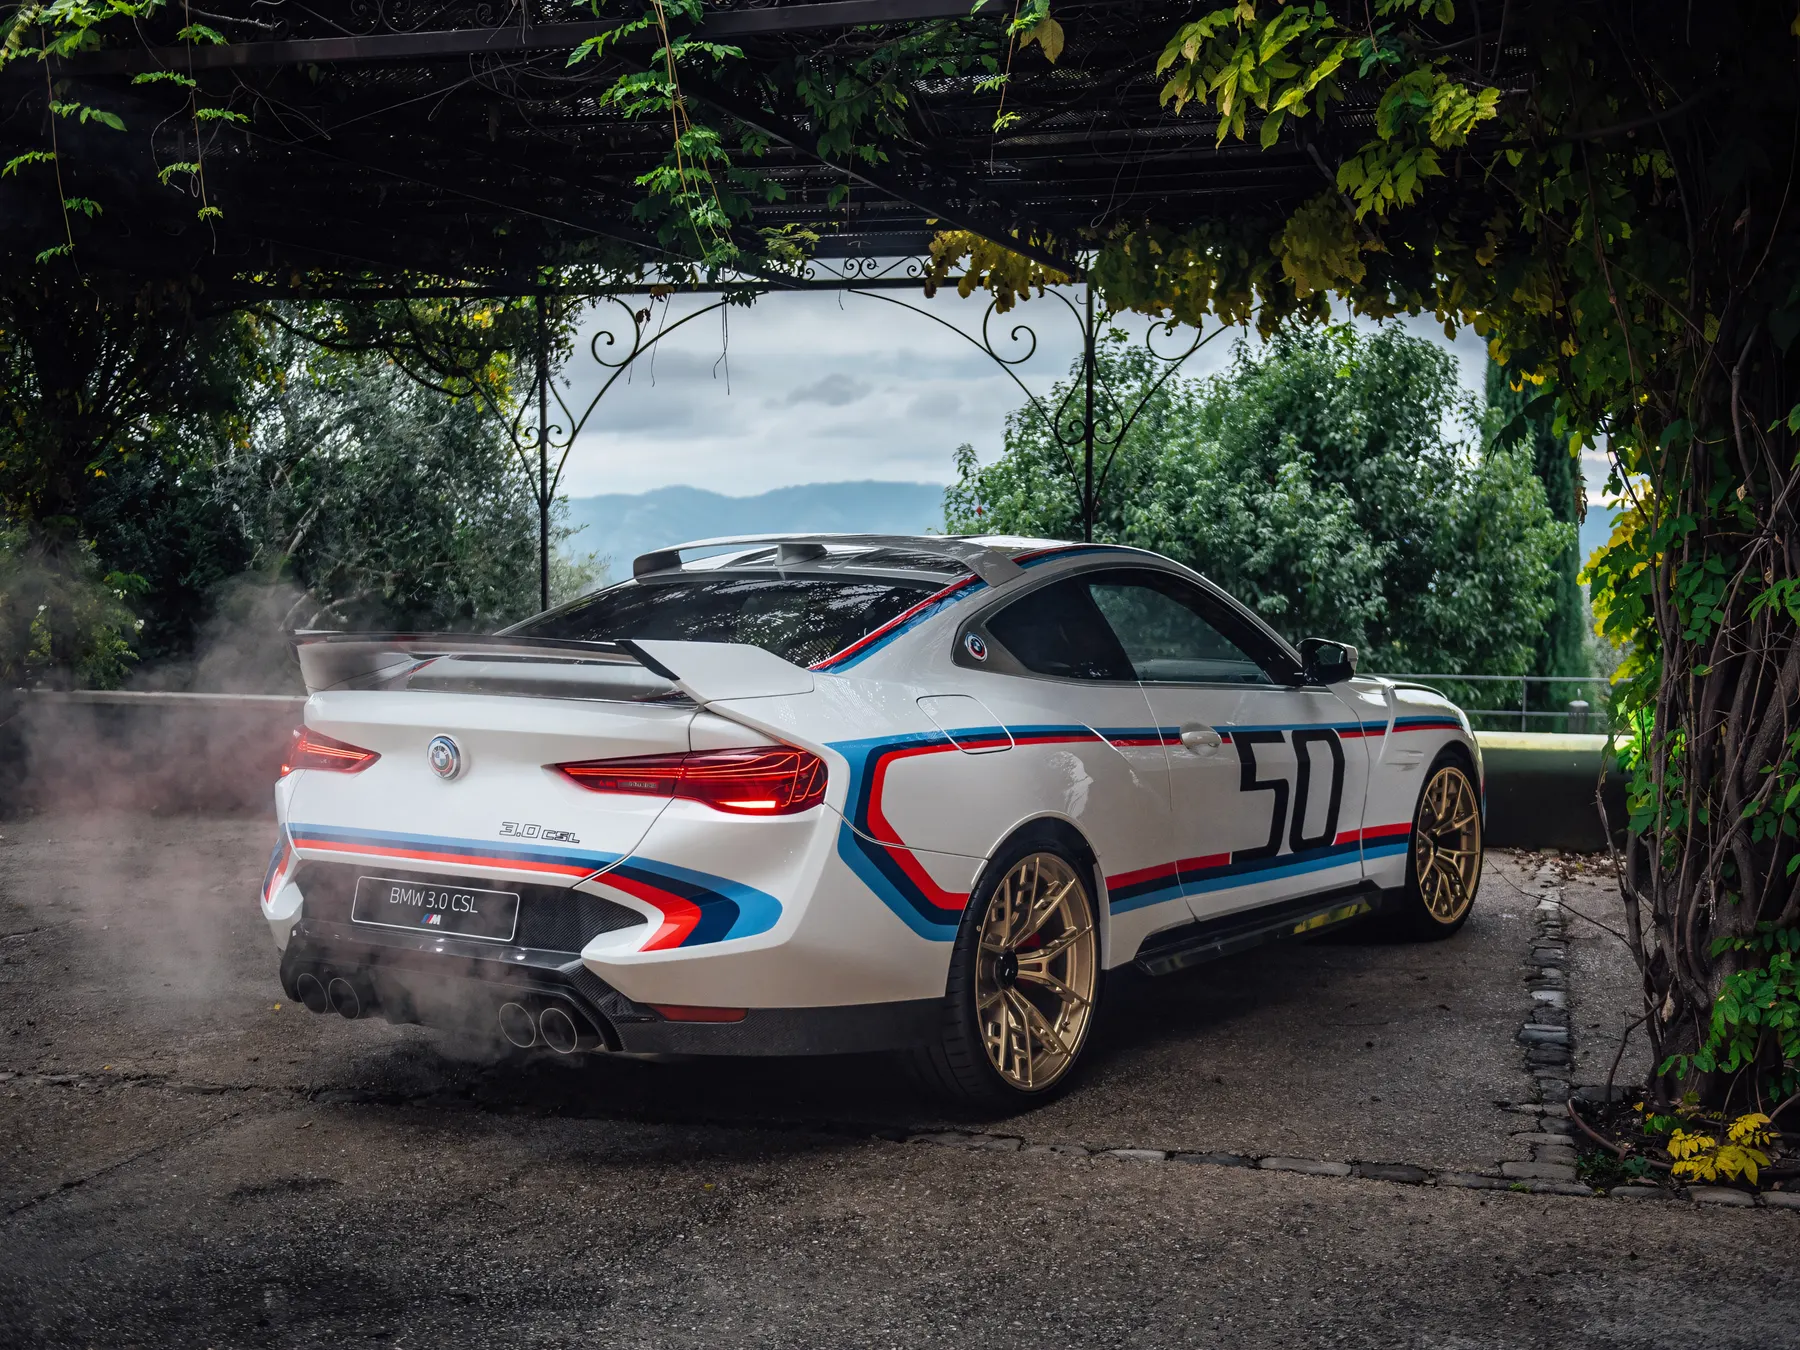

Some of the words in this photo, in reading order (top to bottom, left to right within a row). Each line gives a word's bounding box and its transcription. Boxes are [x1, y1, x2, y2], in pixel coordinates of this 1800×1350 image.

[1230, 729, 1346, 864] 50
[499, 821, 542, 839] 3.0
[541, 829, 581, 844] CSL
[389, 887, 426, 907] BMW
[426, 891, 449, 910] 3.0
[451, 894, 479, 914] CSL
[428, 914, 442, 926] M
